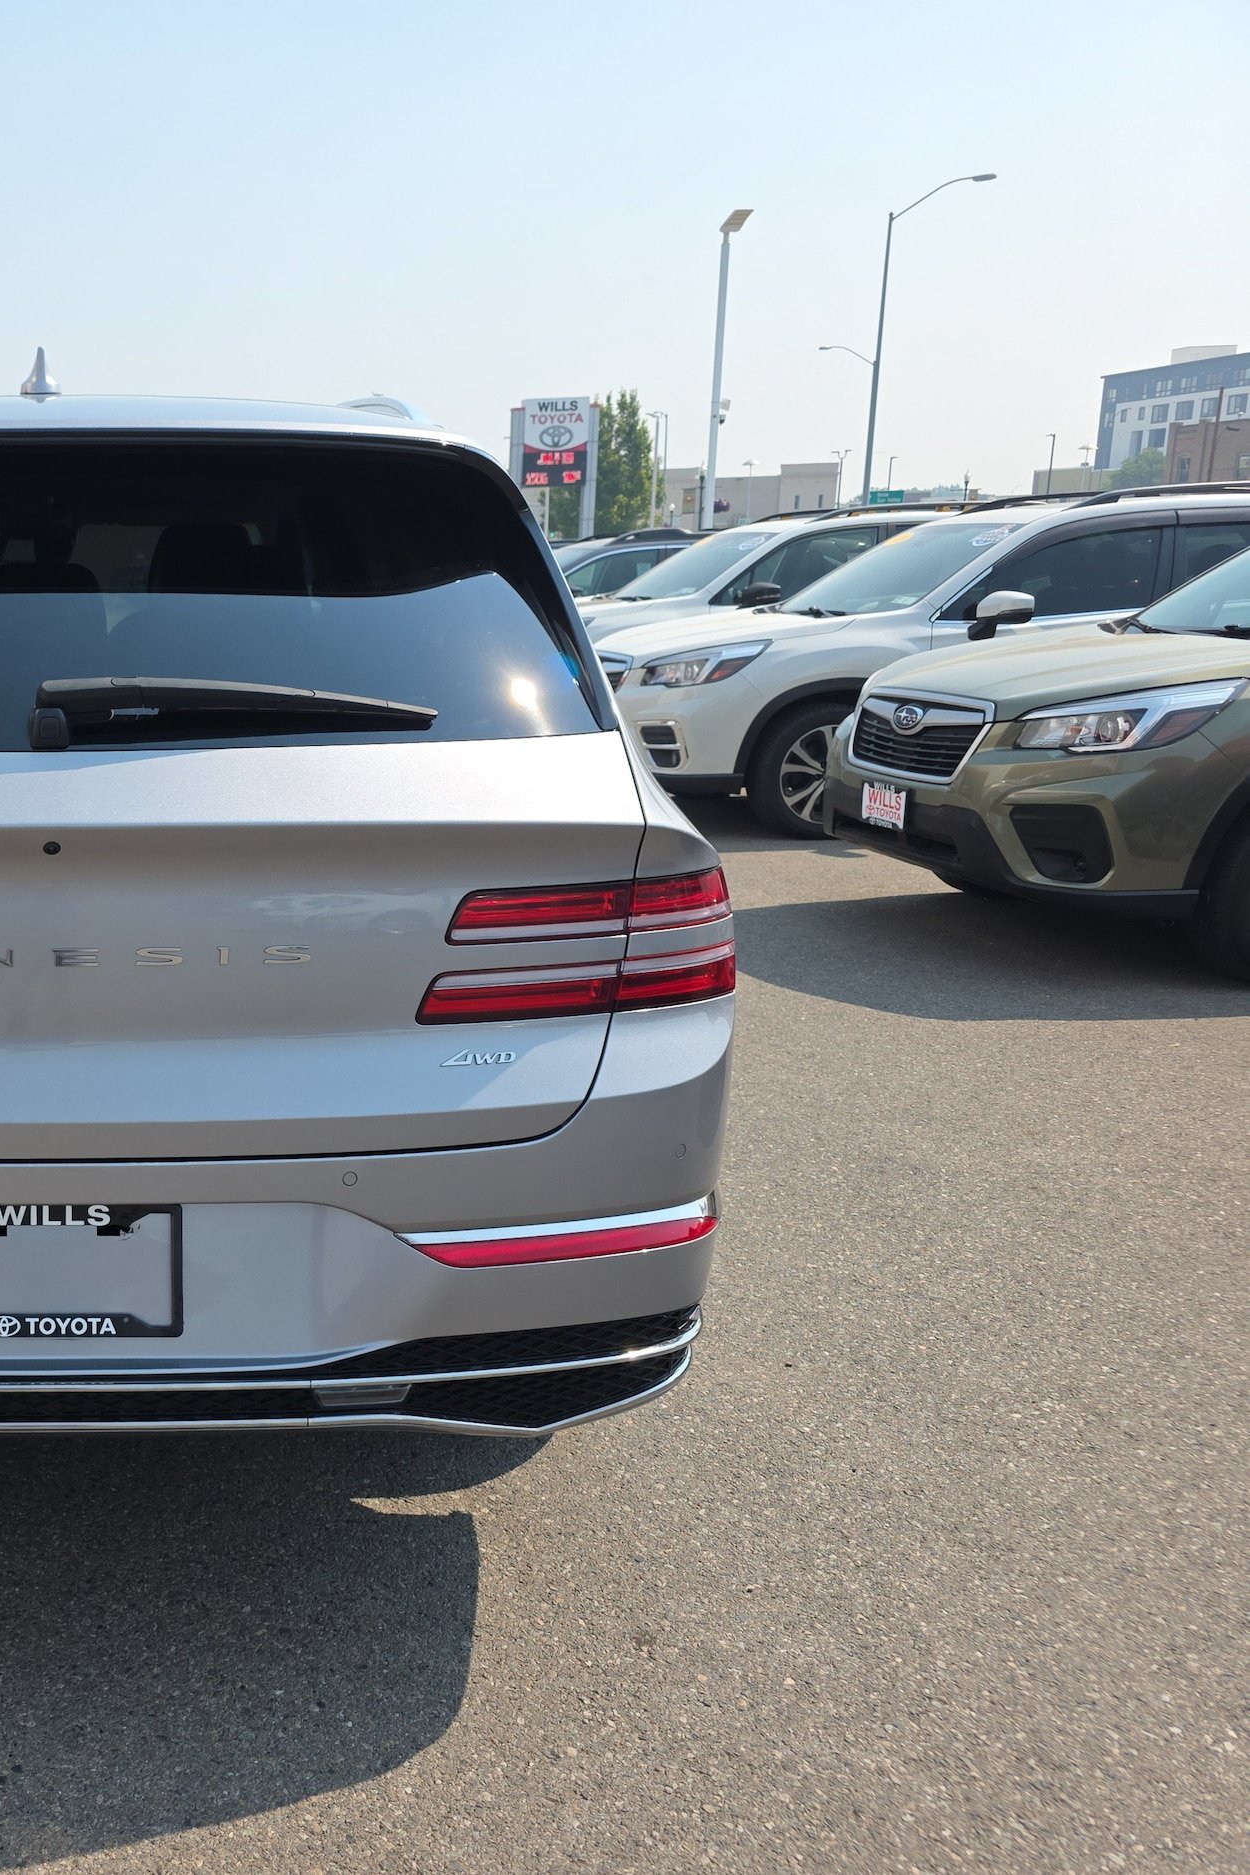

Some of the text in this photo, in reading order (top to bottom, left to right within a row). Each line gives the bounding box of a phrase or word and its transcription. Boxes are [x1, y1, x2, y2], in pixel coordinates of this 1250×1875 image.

[538, 401, 578, 412] WILLS
[530, 413, 584, 425] TOYOTA
[873, 781, 896, 794] WILLS
[868, 788, 902, 811] WILLS
[876, 807, 902, 822] TOYOTA
[25, 1317, 117, 1335] TOYOTA
